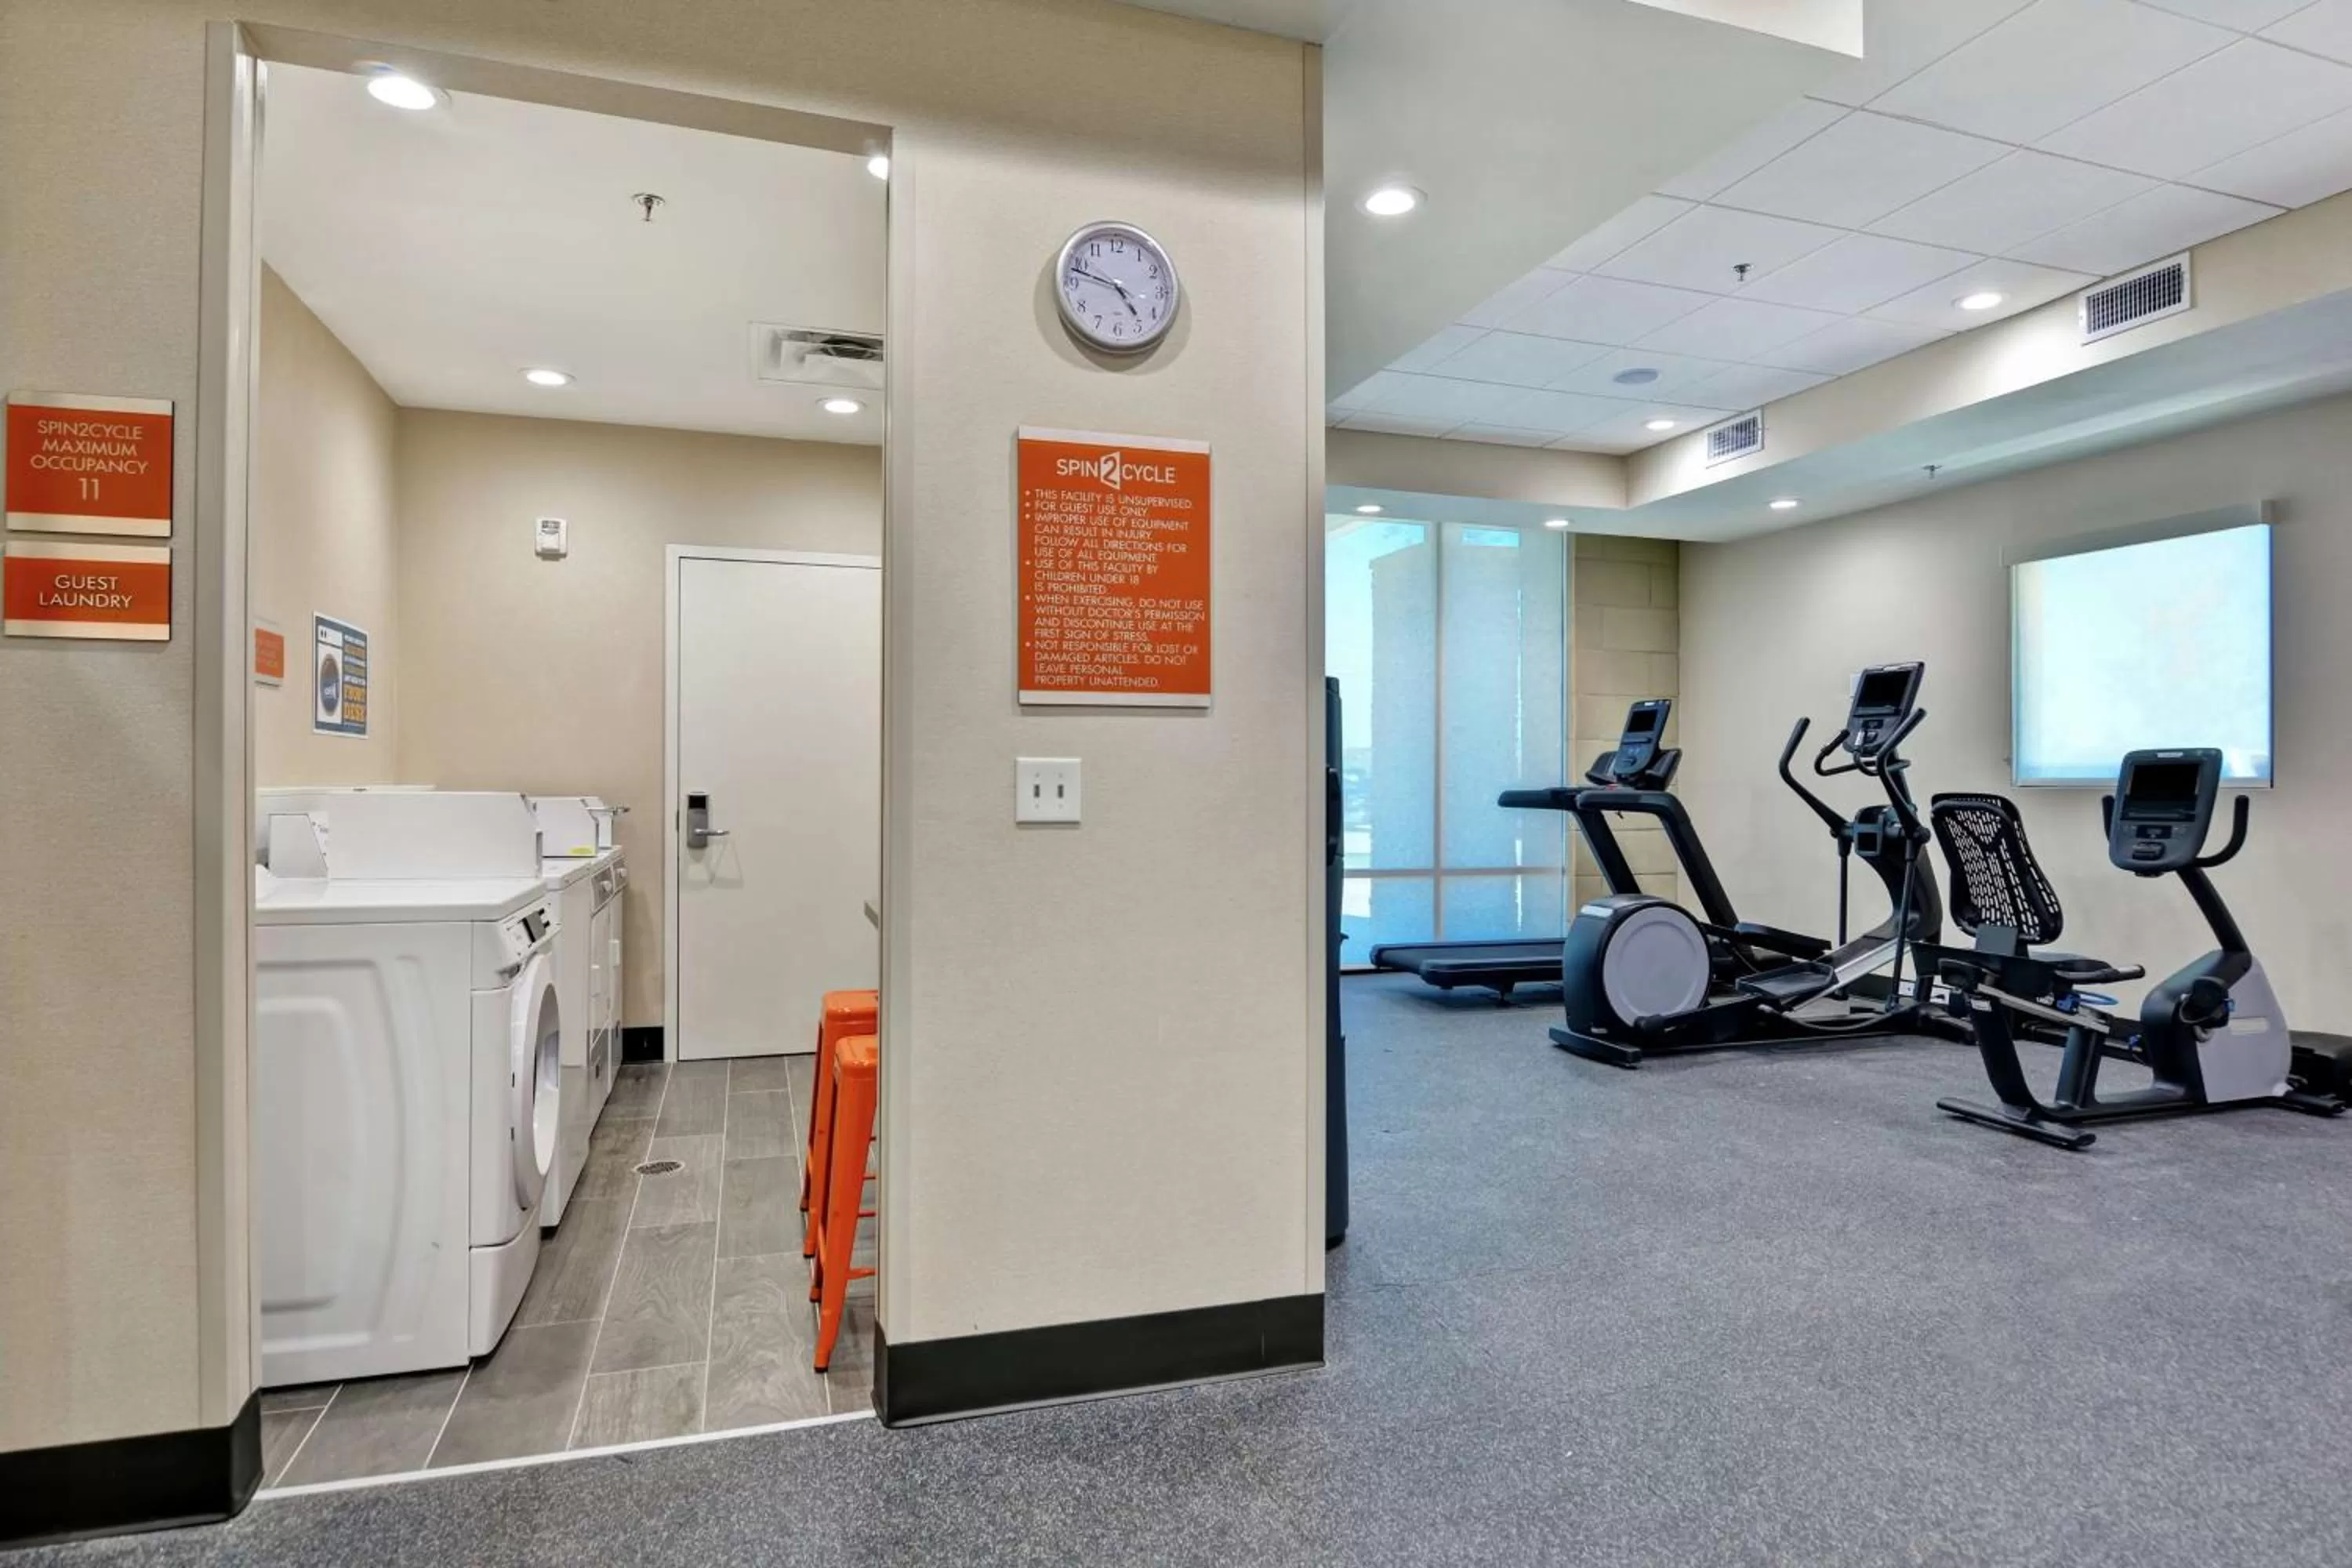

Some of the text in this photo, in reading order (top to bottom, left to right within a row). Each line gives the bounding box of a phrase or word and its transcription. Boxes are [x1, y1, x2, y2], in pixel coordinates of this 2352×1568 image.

[1090, 242, 1101, 257] 11
[1109, 238, 1123, 253] 12
[1149, 264, 1158, 279] 2
[1069, 277, 1079, 289] 9
[1076, 300, 1087, 313] 8
[1094, 315, 1102, 328] 7
[1112, 321, 1123, 336] 6
[1133, 319, 1142, 333] 5
[38, 419, 143, 440] SPIN2CYCLE
[42, 438, 137, 456] MAXIMUM
[30, 455, 148, 474] OCCUPANCY
[78, 477, 100, 500] 11
[1035, 488, 1058, 499] THIS
[1061, 490, 1102, 503] FACILITY
[1105, 492, 1114, 503] IS
[1035, 500, 1056, 511] FOR
[1059, 502, 1093, 514] GUEST
[1097, 504, 1117, 515] USE
[1035, 512, 1189, 531] IMPROPER USE OF EQUIPMENT
[1035, 523, 1059, 534] CAN
[1063, 524, 1098, 536] RESULT
[1102, 527, 1113, 537] IN
[1035, 535, 1188, 553] FOLLOW ALL DIRECTIONS FOR
[1035, 546, 1054, 557] USE
[1058, 548, 1073, 558] OF
[1077, 549, 1095, 559] ALL
[1035, 558, 1159, 575] USE OF THIS FACILITY BY
[54, 575, 118, 590] GUEST
[1035, 570, 1140, 585] CHILDREN UNDER 18
[1035, 581, 1044, 591] IS
[39, 592, 132, 608] LAUNDRY
[1035, 593, 1069, 604] WHEN
[1139, 598, 1156, 608] DO
[1160, 599, 1181, 609] NOT
[1185, 599, 1203, 610] USE
[1035, 604, 1085, 615] WITHOUT
[1145, 609, 1205, 622] PERMISSION
[1035, 617, 1194, 632] AND DISCONTINUE USE AT THE
[1035, 628, 1060, 639] FIRST
[1064, 630, 1091, 639] SIGN
[1094, 630, 1109, 641] OF
[1035, 640, 1198, 655] NOT RESPONSIBLE FOR LOST OR
[1035, 652, 1091, 663] DAMAGED
[1145, 655, 1160, 665] DO
[1164, 655, 1187, 666] NOT
[1035, 662, 1123, 675] LEAVE PERSONAL
[1035, 674, 1086, 685] PROPERTY
